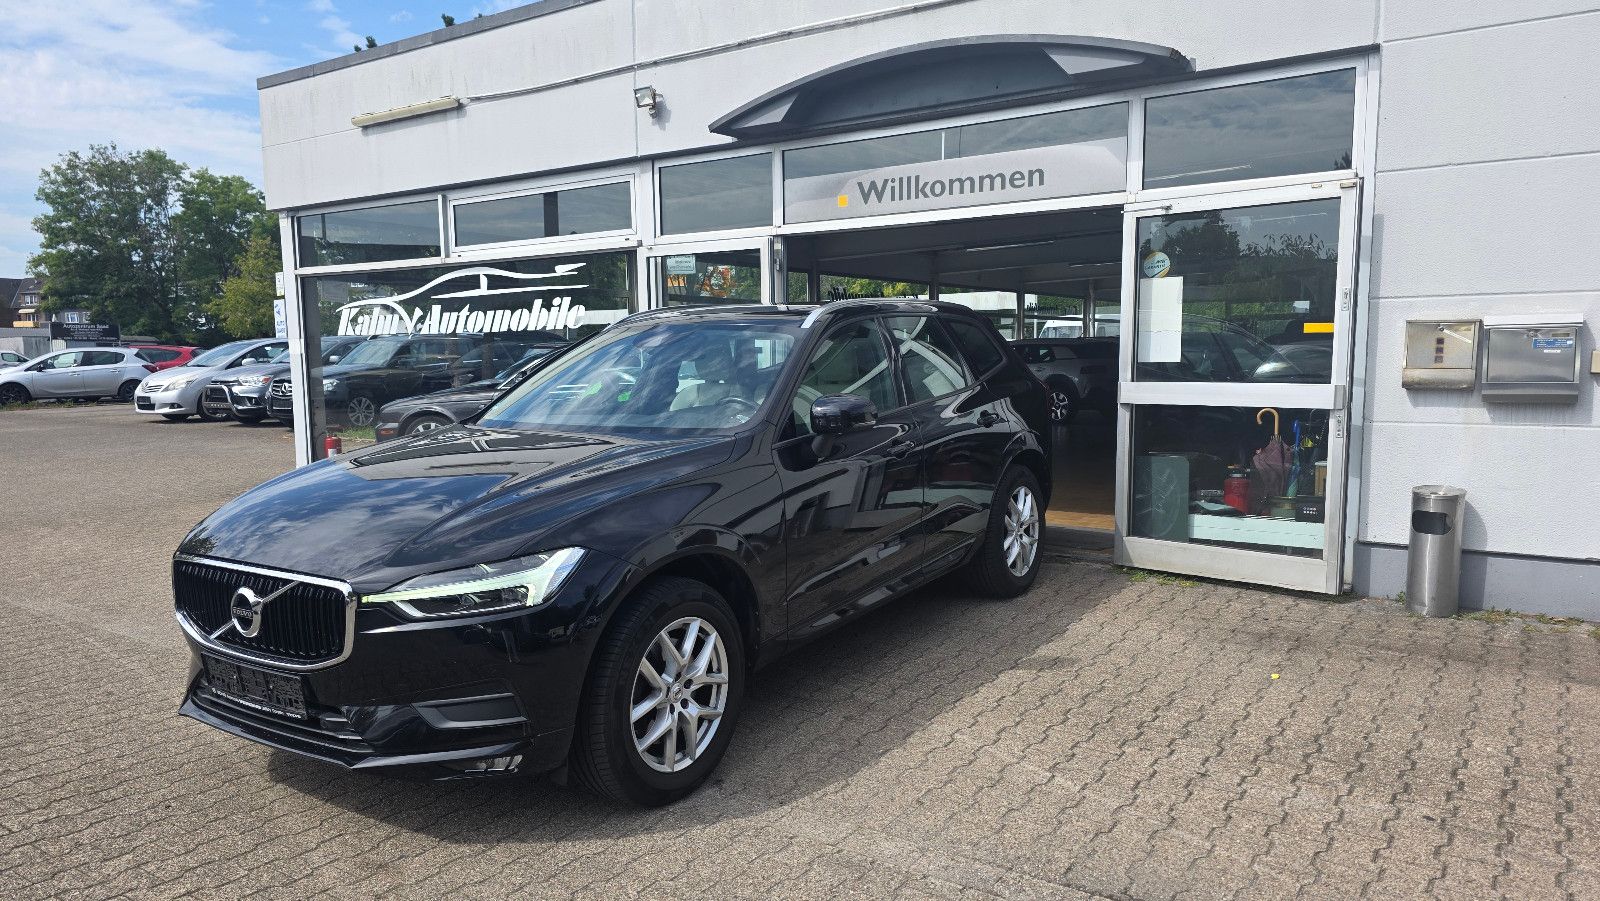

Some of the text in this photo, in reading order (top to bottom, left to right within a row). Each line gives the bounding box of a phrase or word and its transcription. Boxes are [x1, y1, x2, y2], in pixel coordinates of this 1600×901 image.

[857, 168, 1045, 205] Willkommen
[419, 297, 586, 334] Automobile
[232, 609, 252, 618] VOLVO
